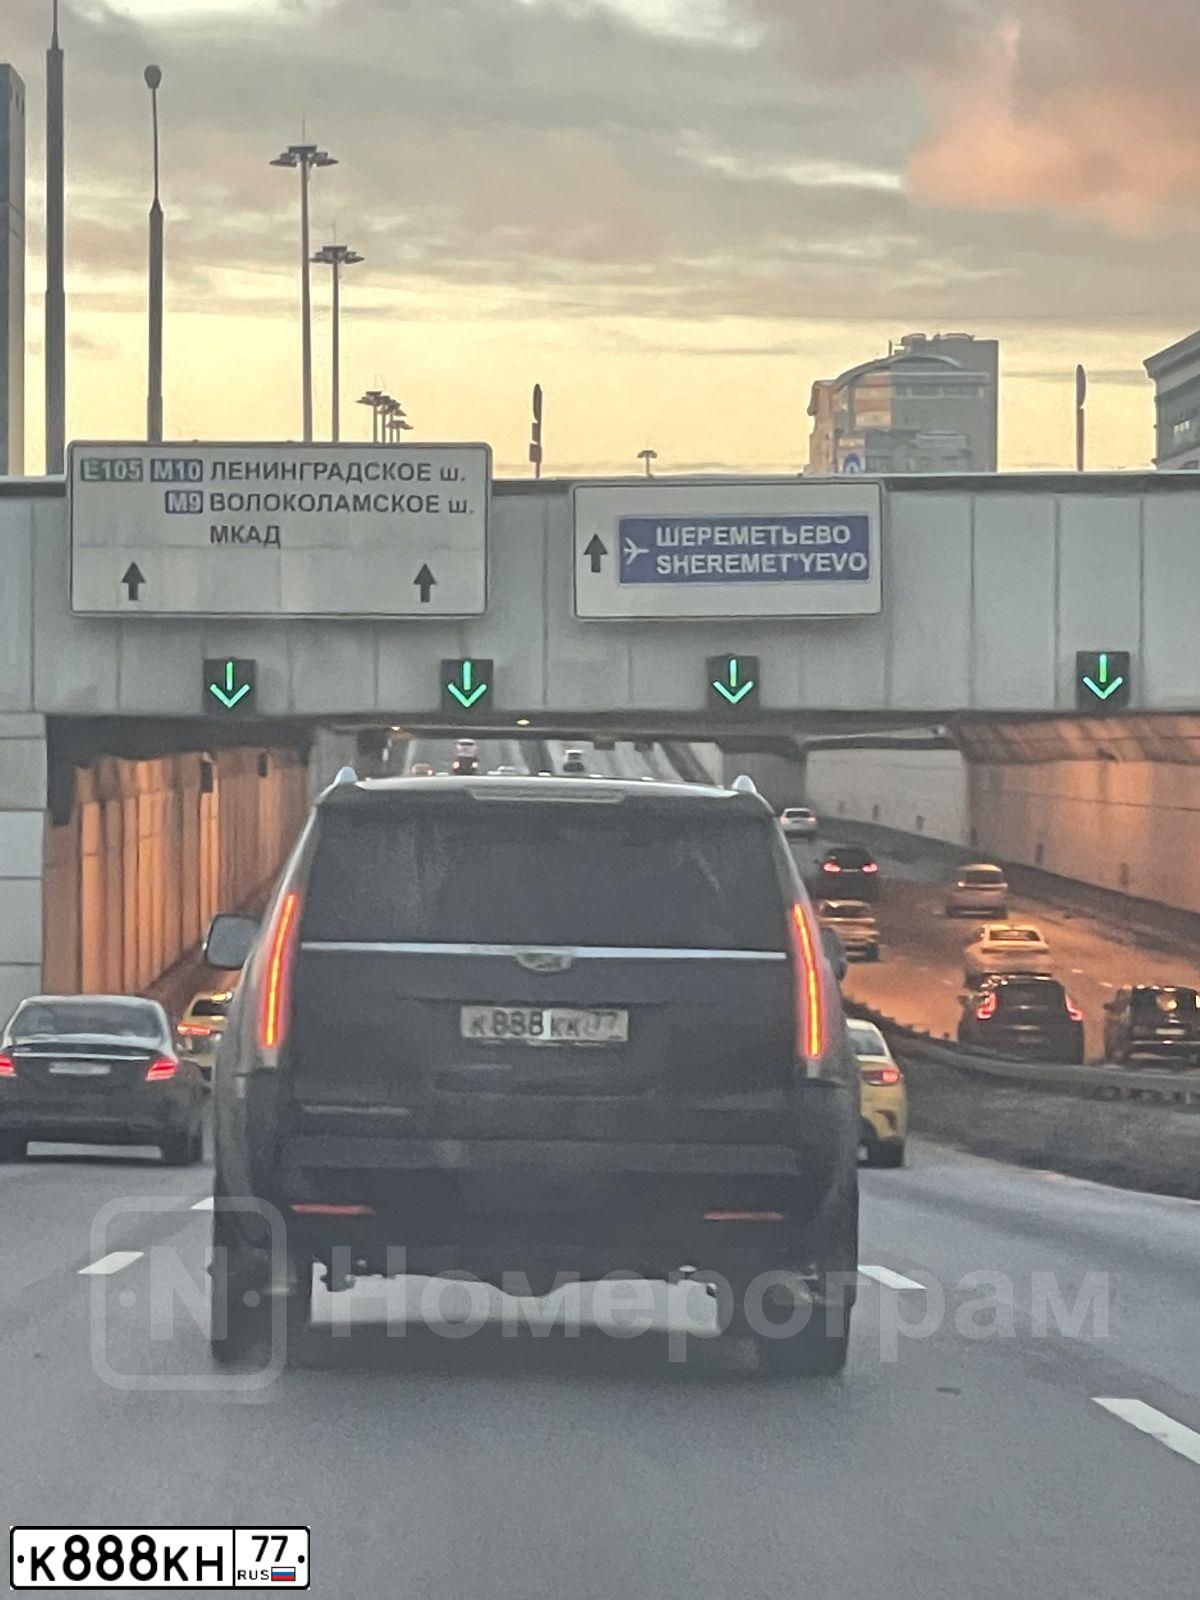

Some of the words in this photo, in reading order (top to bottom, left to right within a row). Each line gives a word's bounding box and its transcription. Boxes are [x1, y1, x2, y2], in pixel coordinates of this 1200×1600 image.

[210, 461, 431, 484] ЛЕНИНГРАДСКОЕ
[440, 467, 466, 482] ш.
[210, 493, 440, 514] ВОЛОКОЛАМСКОЕ
[448, 498, 475, 514] ш.
[210, 525, 281, 548] МКАД
[656, 525, 850, 547] ШЕРЕМЕТЬЕВО
[656, 552, 868, 575] SHEREMET'YEVO
